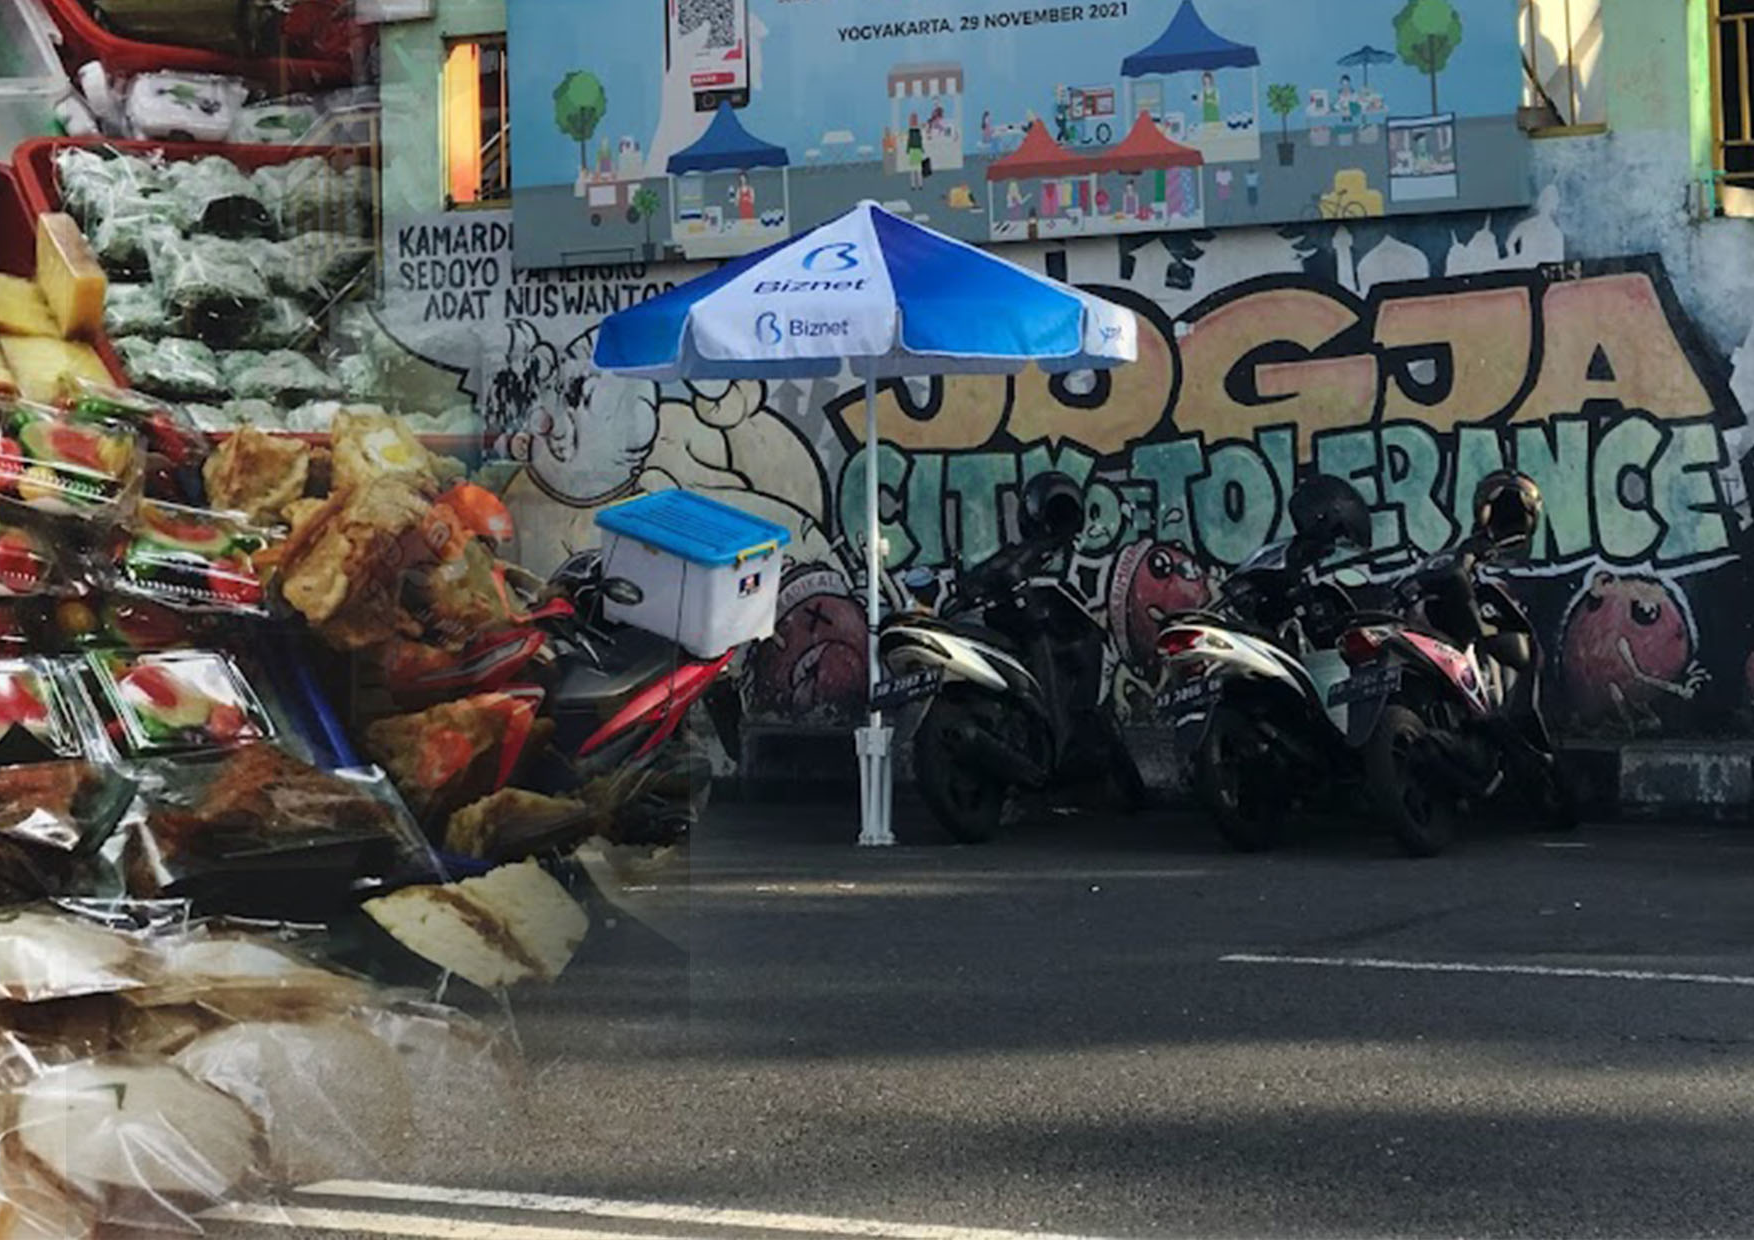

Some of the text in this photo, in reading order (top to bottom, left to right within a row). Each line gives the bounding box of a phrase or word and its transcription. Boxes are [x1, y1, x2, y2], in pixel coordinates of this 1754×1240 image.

[837, 1, 1129, 42] YOGYAKARTA, 29 NOVEMBER 2021
[398, 257, 500, 291] SEDOYO
[753, 276, 867, 295] Biznet
[423, 290, 492, 322] ADAT
[788, 319, 849, 338] Biznet
[842, 446, 1096, 568] CITY
[1130, 414, 1730, 562] TOLERANCE
